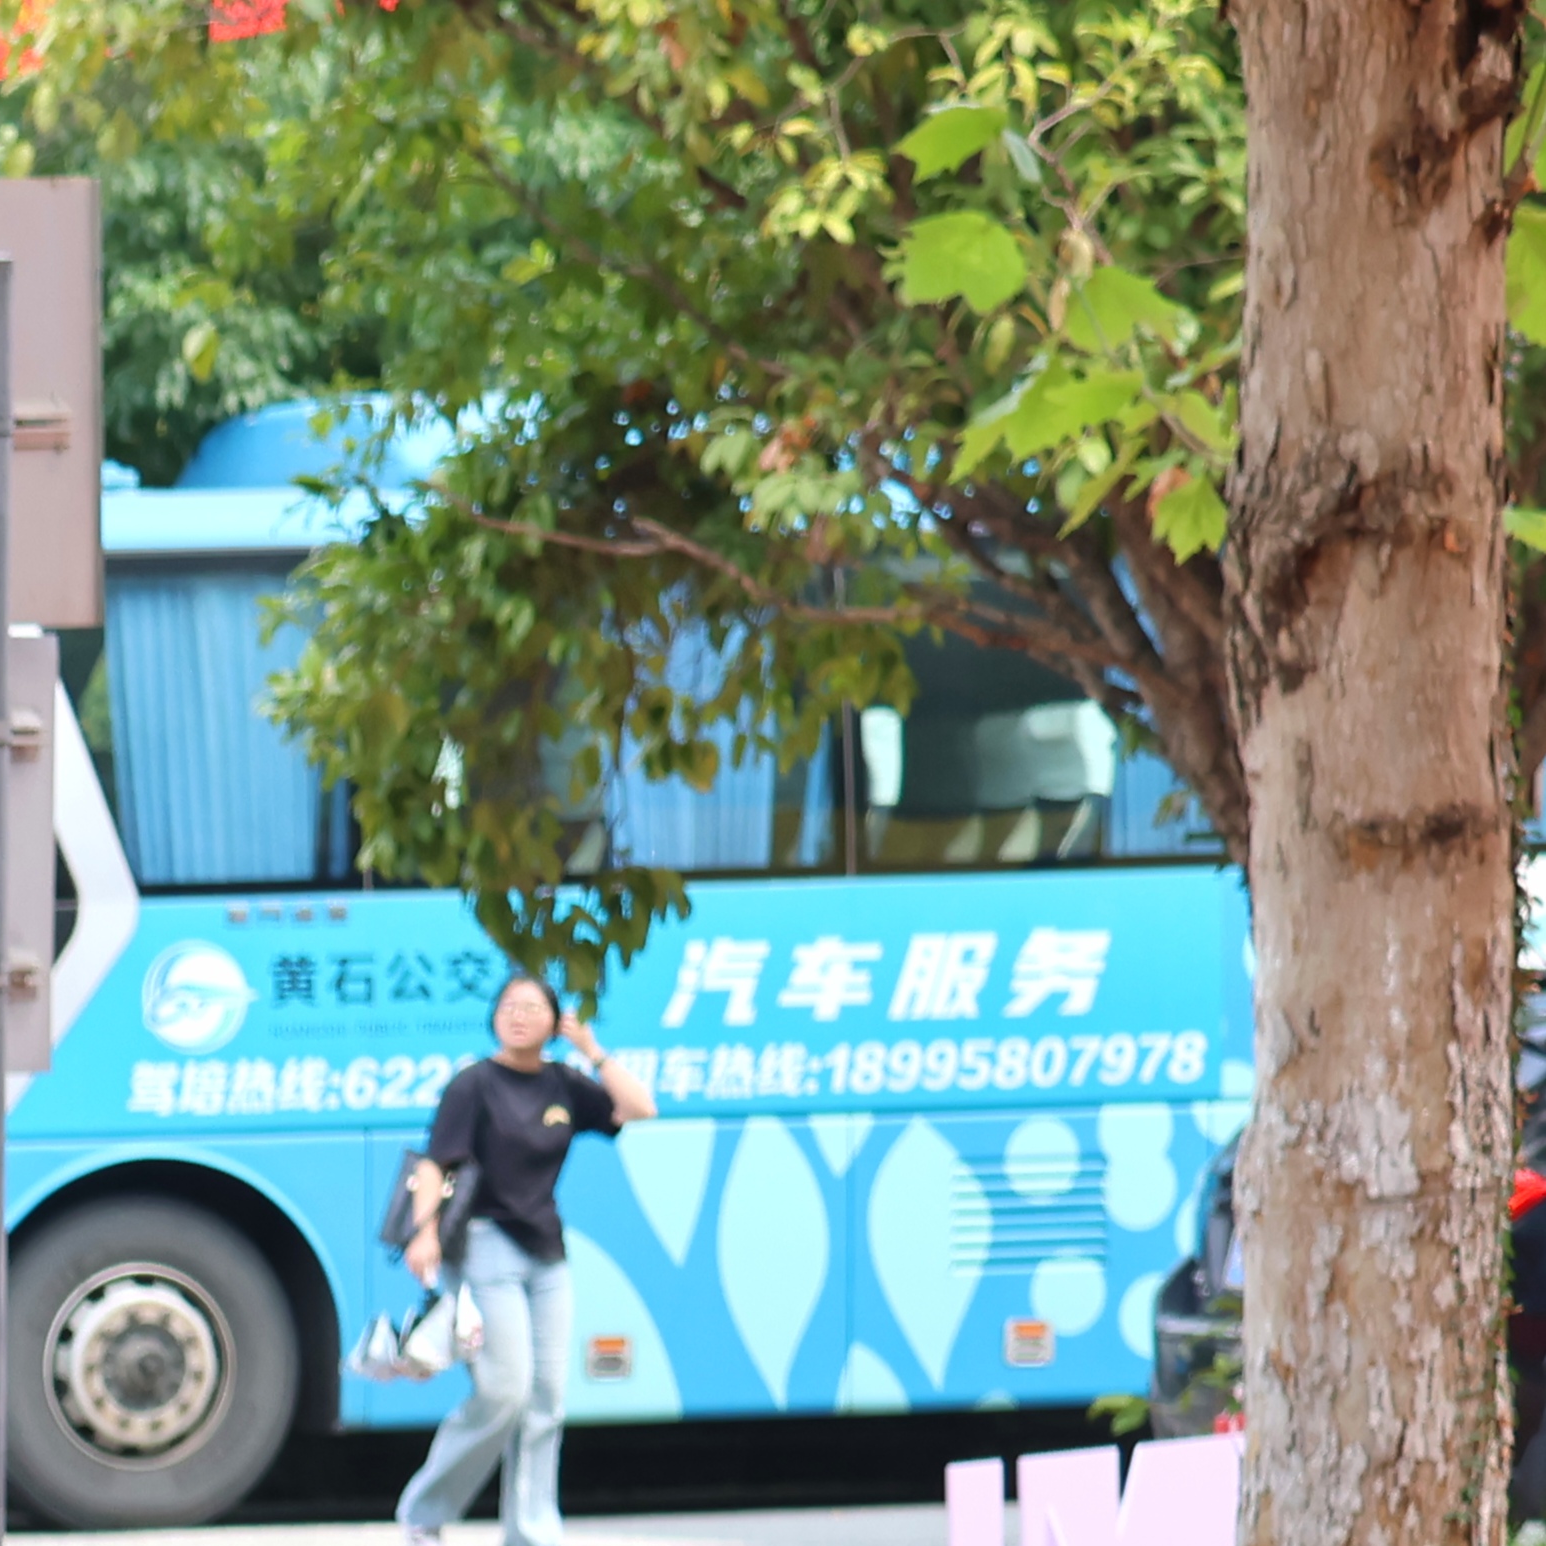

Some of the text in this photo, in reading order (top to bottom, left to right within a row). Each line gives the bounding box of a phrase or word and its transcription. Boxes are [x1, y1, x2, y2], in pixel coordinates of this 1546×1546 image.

[272, 952, 492, 1007] 黄石公交
[661, 926, 1111, 1028] 汽车服务
